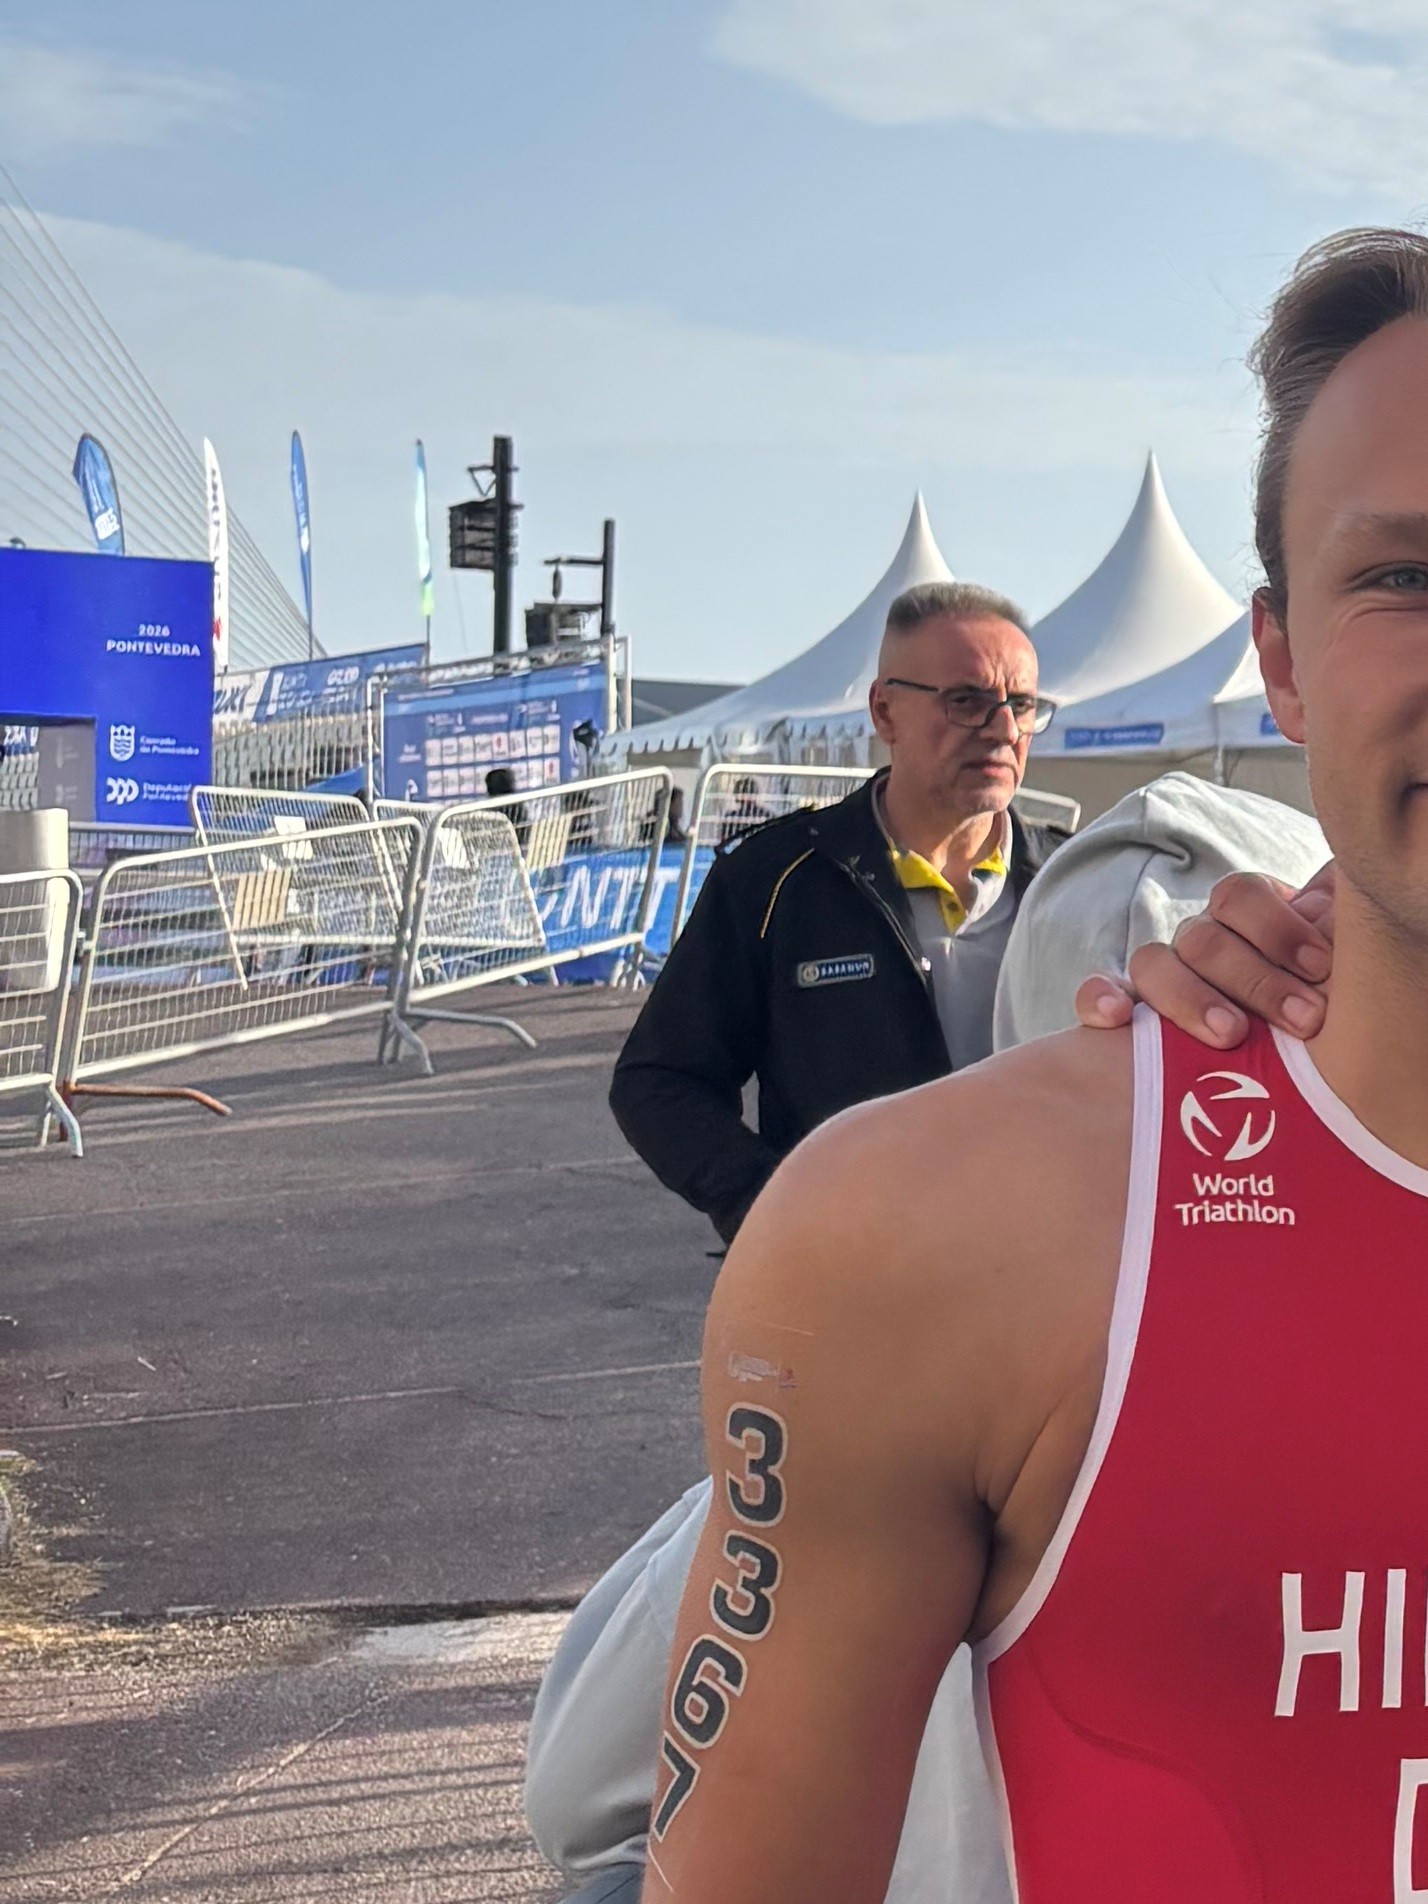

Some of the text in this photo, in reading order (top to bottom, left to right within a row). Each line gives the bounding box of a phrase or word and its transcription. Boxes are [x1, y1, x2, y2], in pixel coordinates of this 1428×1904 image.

[138, 623, 170, 637] 2026
[106, 639, 201, 657] PONTEVEDRA
[1192, 1173, 1275, 1197] World
[1173, 1199, 1296, 1226] Triathlon
[653, 1401, 788, 1843] 3367
